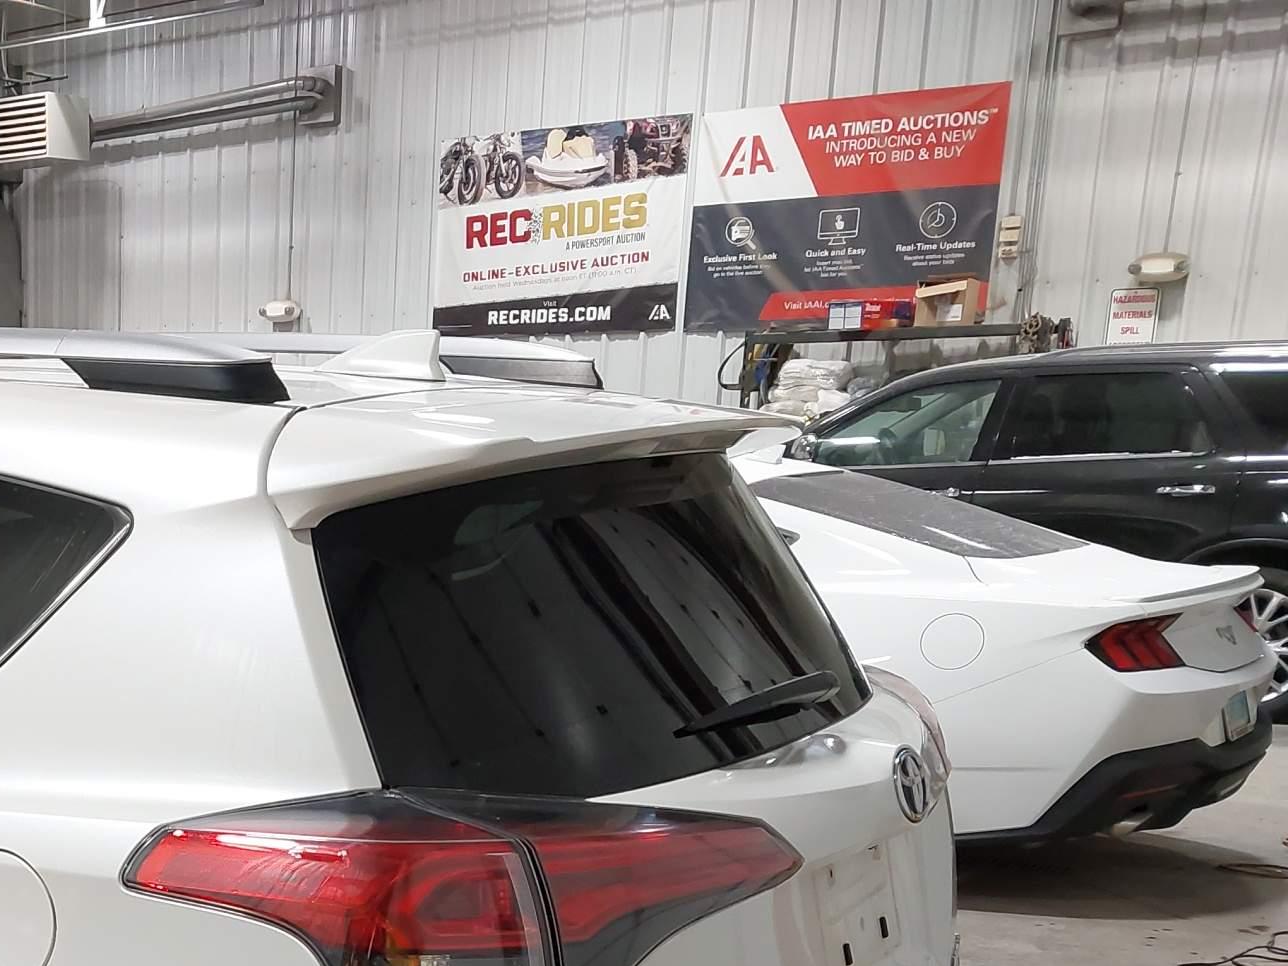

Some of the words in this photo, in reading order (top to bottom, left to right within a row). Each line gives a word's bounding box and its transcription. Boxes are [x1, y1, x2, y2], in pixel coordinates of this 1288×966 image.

[808, 124, 837, 140] IAA
[841, 118, 892, 136] TIMED
[826, 136, 922, 153] INTRODUCING
[926, 132, 937, 145] A
[941, 128, 976, 142] NEW
[834, 154, 864, 168] WAY
[868, 151, 886, 164] TO
[891, 149, 914, 162] BID
[918, 147, 929, 160] &
[934, 144, 965, 158] BUY
[466, 208, 533, 249] REC
[542, 192, 648, 240] RIDES
[566, 242, 571, 251] A
[571, 236, 614, 250] POWERSPORT
[616, 231, 646, 244] AUCTION
[896, 242, 937, 252] Real-Time
[939, 240, 976, 250] Updates
[703, 254, 737, 264] Exclusive
[739, 253, 756, 262] First
[758, 251, 778, 261] Look
[805, 249, 829, 258] Quick
[830, 248, 846, 257] and
[848, 246, 866, 257] Easy
[463, 259, 587, 282] ONLINE-EXCLUSIVE
[591, 251, 650, 268] AUCTION
[543, 299, 557, 307] Visit
[784, 301, 802, 310] Visit
[488, 306, 611, 325] RECRIDES.COM
[1112, 310, 1153, 319] MATERIALS
[1120, 327, 1139, 335] SPILL
